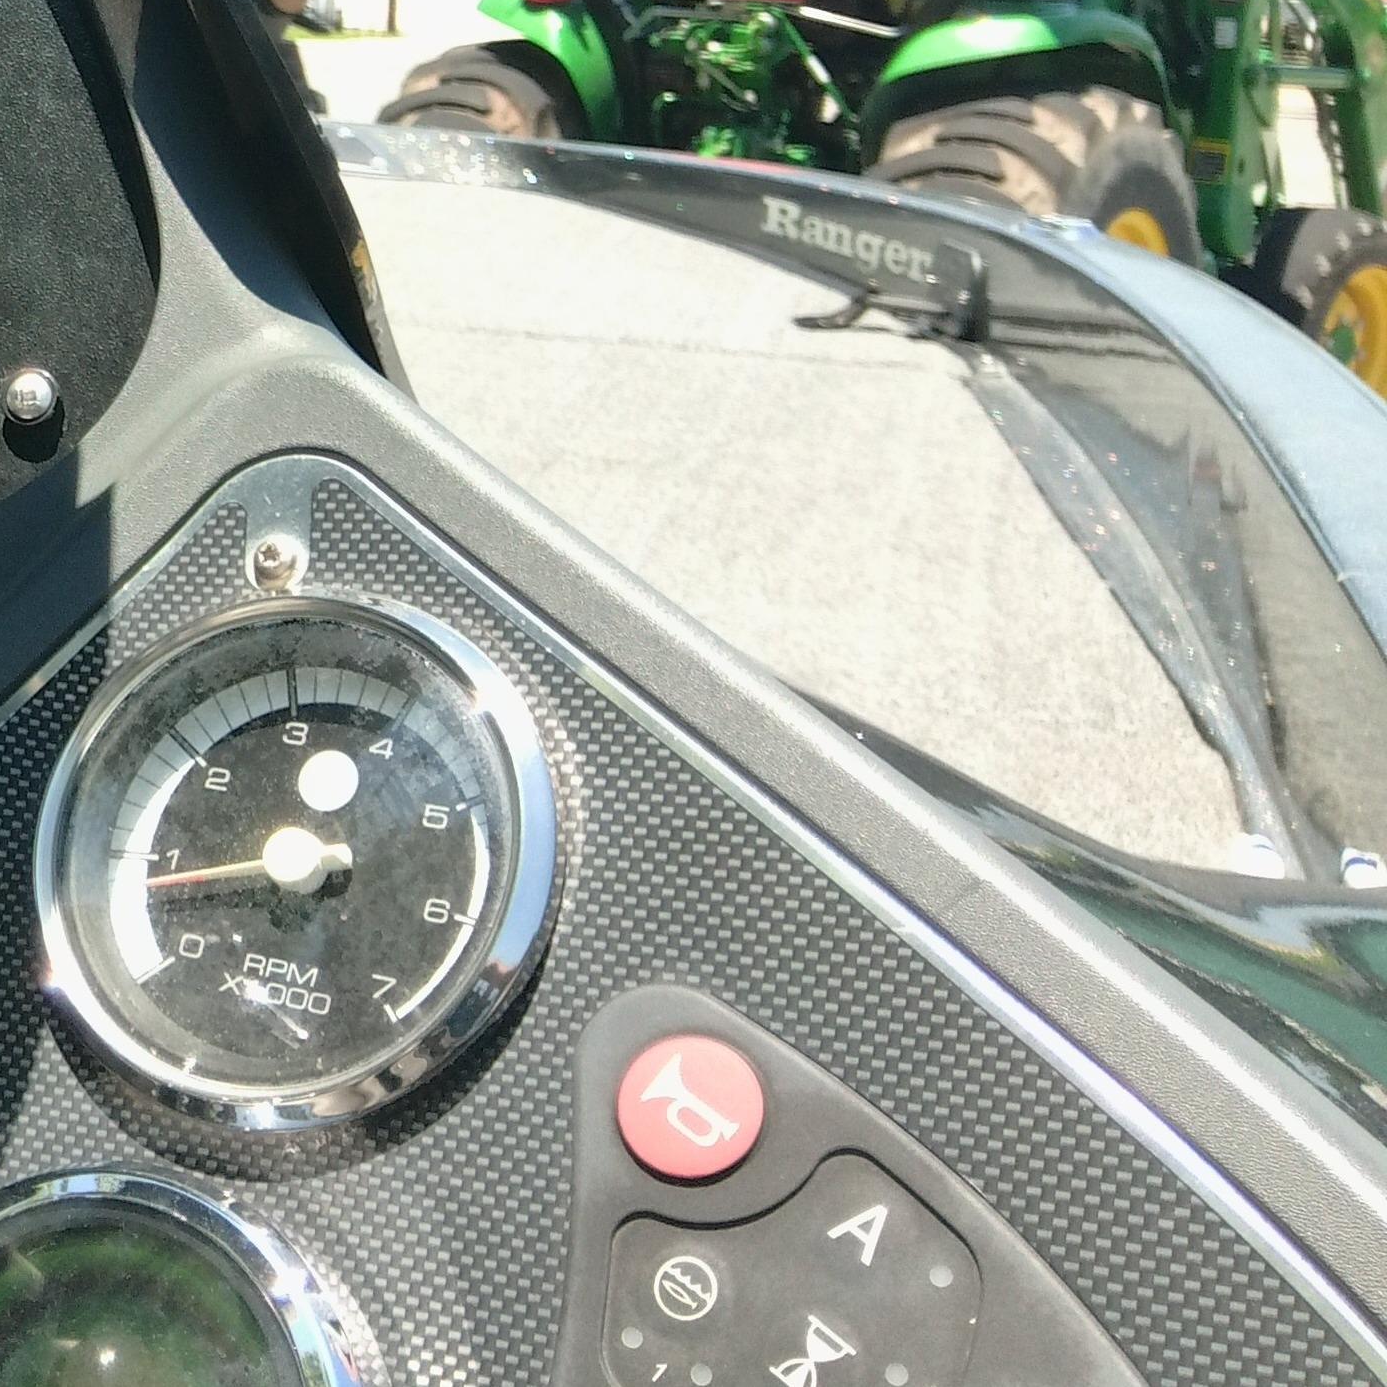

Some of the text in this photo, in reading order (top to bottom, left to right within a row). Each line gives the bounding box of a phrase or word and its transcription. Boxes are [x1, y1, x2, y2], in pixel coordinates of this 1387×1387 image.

[760, 195, 935, 282] Ranger
[281, 722, 309, 747] 3
[369, 738, 395, 760] 4
[204, 767, 231, 792] 2
[422, 804, 450, 830] 5
[165, 849, 181, 870] 1
[423, 899, 452, 925] 6
[179, 932, 205, 958] 0
[243, 953, 319, 988] RPM
[218, 972, 331, 1015] X000
[371, 973, 398, 999] 7
[827, 1204, 889, 1266] A
[652, 1363, 668, 1383] 1
